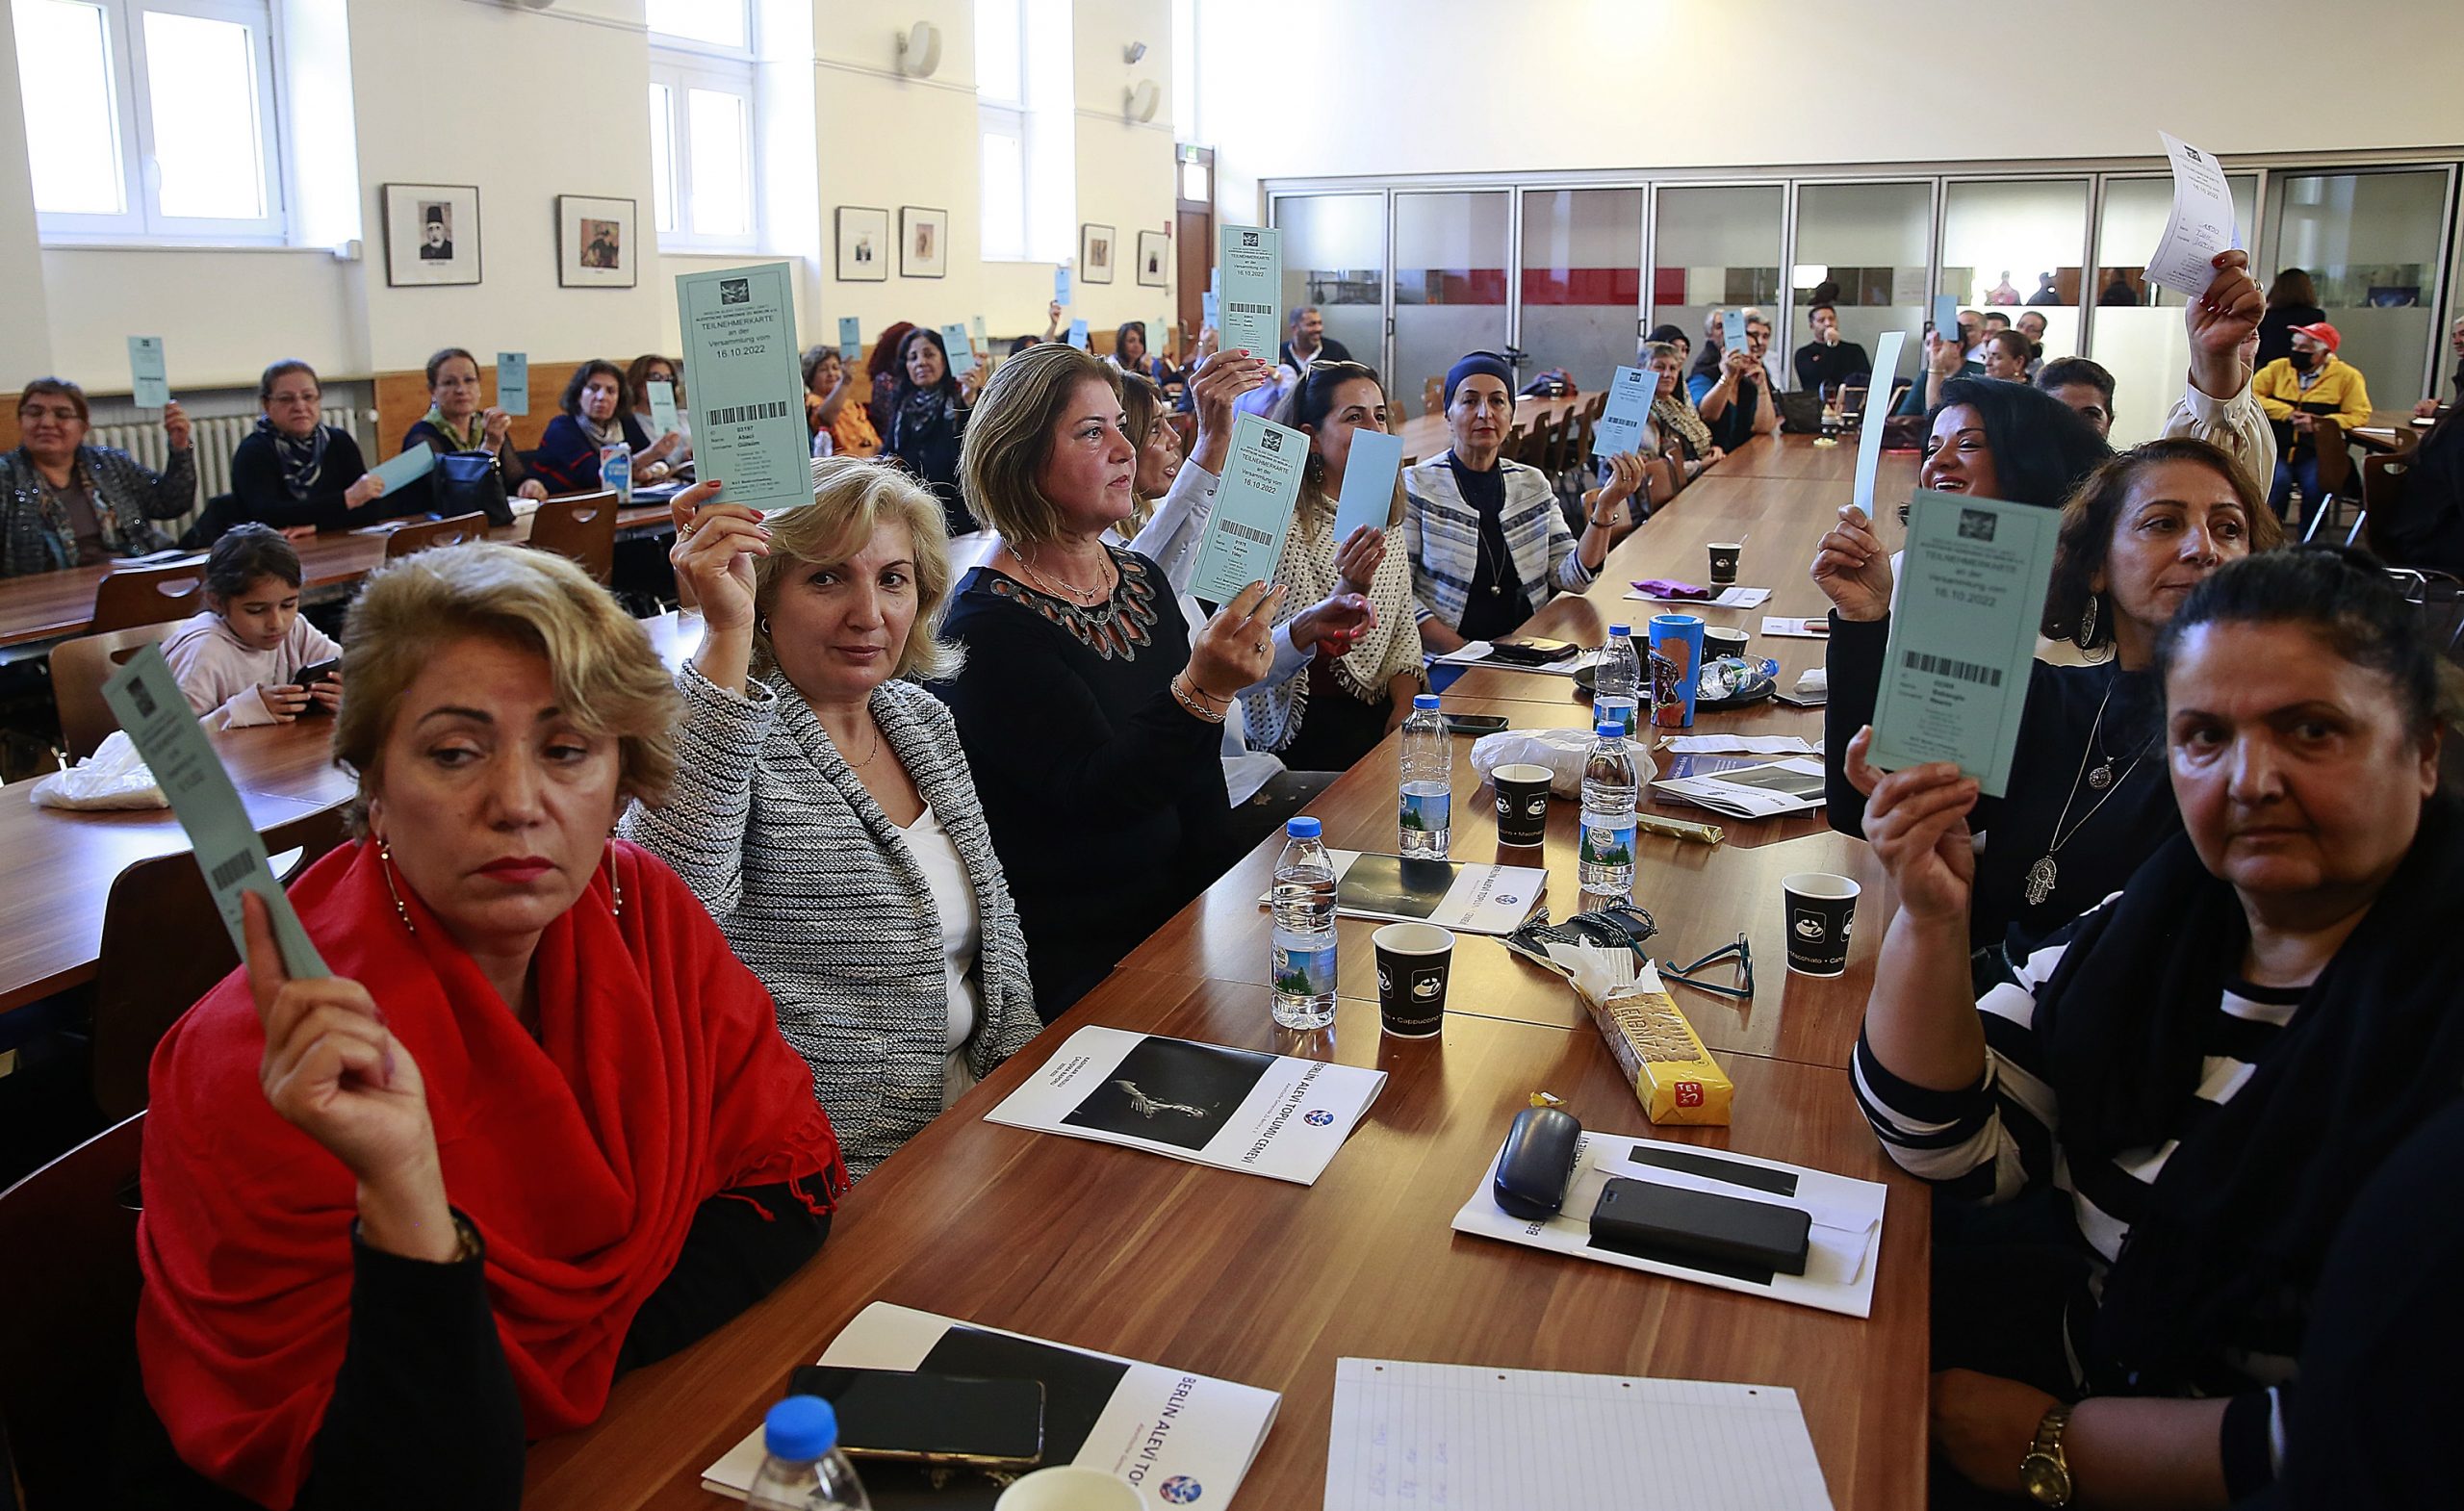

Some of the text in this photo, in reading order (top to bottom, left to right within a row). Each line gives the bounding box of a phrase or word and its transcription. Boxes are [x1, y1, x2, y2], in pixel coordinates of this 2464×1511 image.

[702, 315, 773, 330] TEILNEHMERKARTE
[708, 335, 755, 347] Versammlung
[1241, 452, 1289, 474] TEILNEHMERKARTE
[1241, 468, 1272, 483] Versammlung
[1243, 477, 1276, 494] 16.10.2022
[1289, 1081, 1309, 1103] ALEVİ
[1262, 1105, 1296, 1139] TOPLUMU
[1240, 1140, 1269, 1164] CEMEVİ
[1162, 1377, 1196, 1418] BERLİN
[1140, 1420, 1170, 1460] ALEVİ
